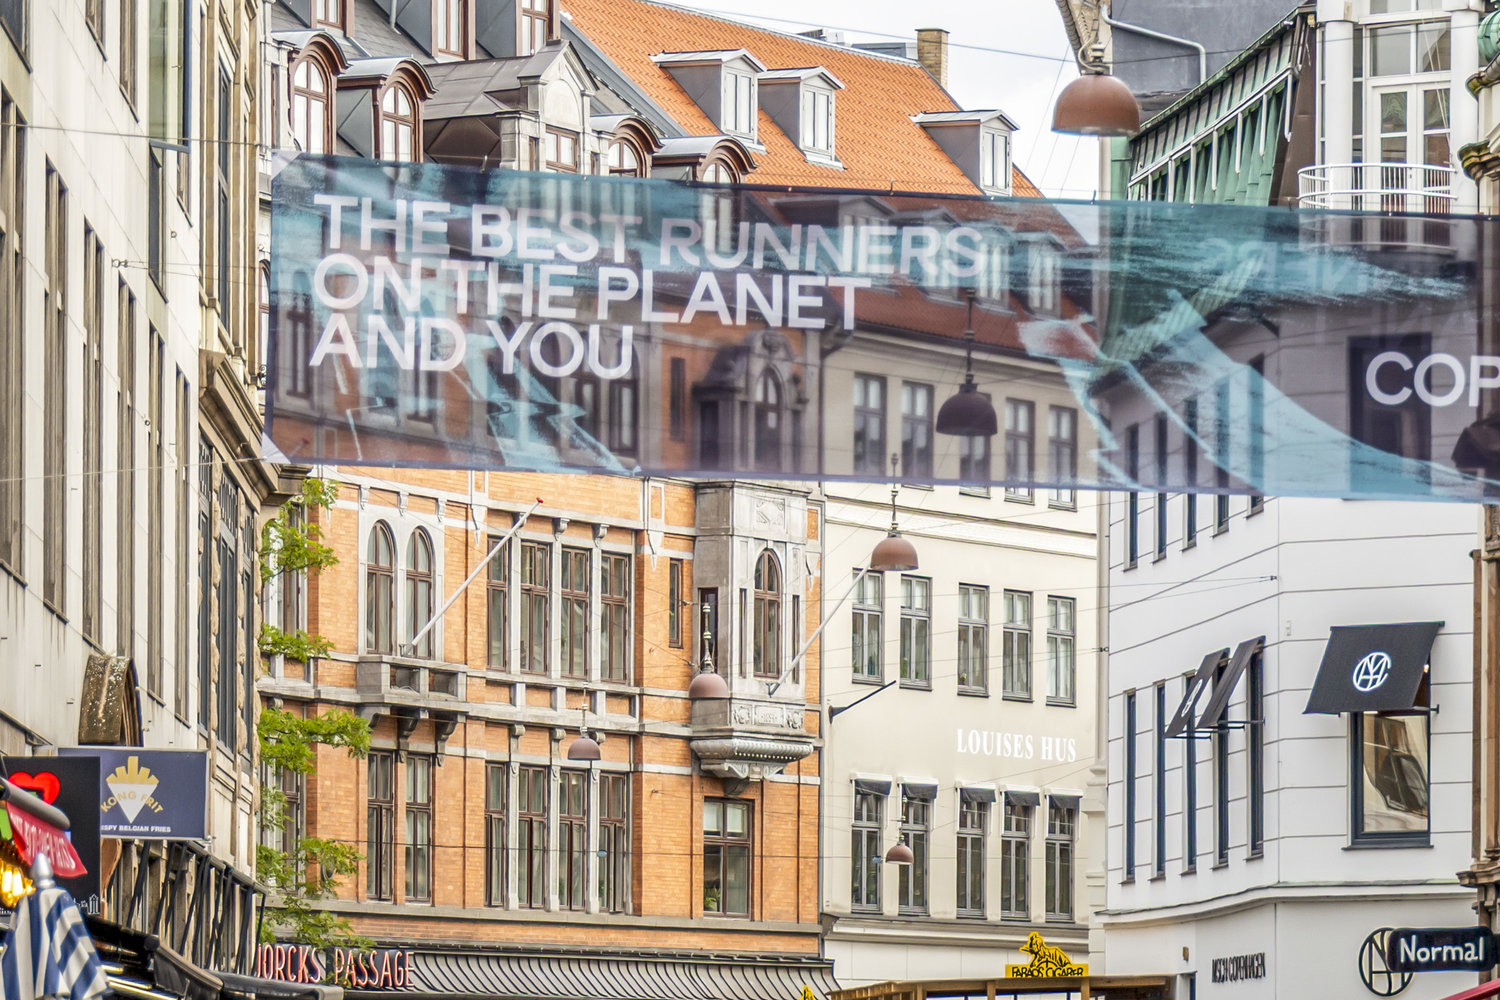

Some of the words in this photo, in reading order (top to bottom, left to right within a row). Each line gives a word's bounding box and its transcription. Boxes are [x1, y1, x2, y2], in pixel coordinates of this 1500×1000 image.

[312, 195, 450, 256] THE
[472, 203, 642, 264] BEST
[661, 216, 983, 279] RUNNERS
[314, 253, 421, 313] ON
[441, 259, 576, 319] THE
[598, 266, 873, 331] PLANET
[309, 314, 466, 372] AND
[485, 320, 635, 380] YOU
[957, 728, 1033, 760] LOUISES
[1041, 736, 1077, 762] HUS
[101, 791, 137, 813] KONG
[101, 824, 117, 832] ISPY
[1400, 935, 1485, 963] Normal
[334, 947, 415, 988] PASSAGE
[1012, 966, 1045, 977] FARAOS
[1045, 966, 1084, 977] CIGARER
